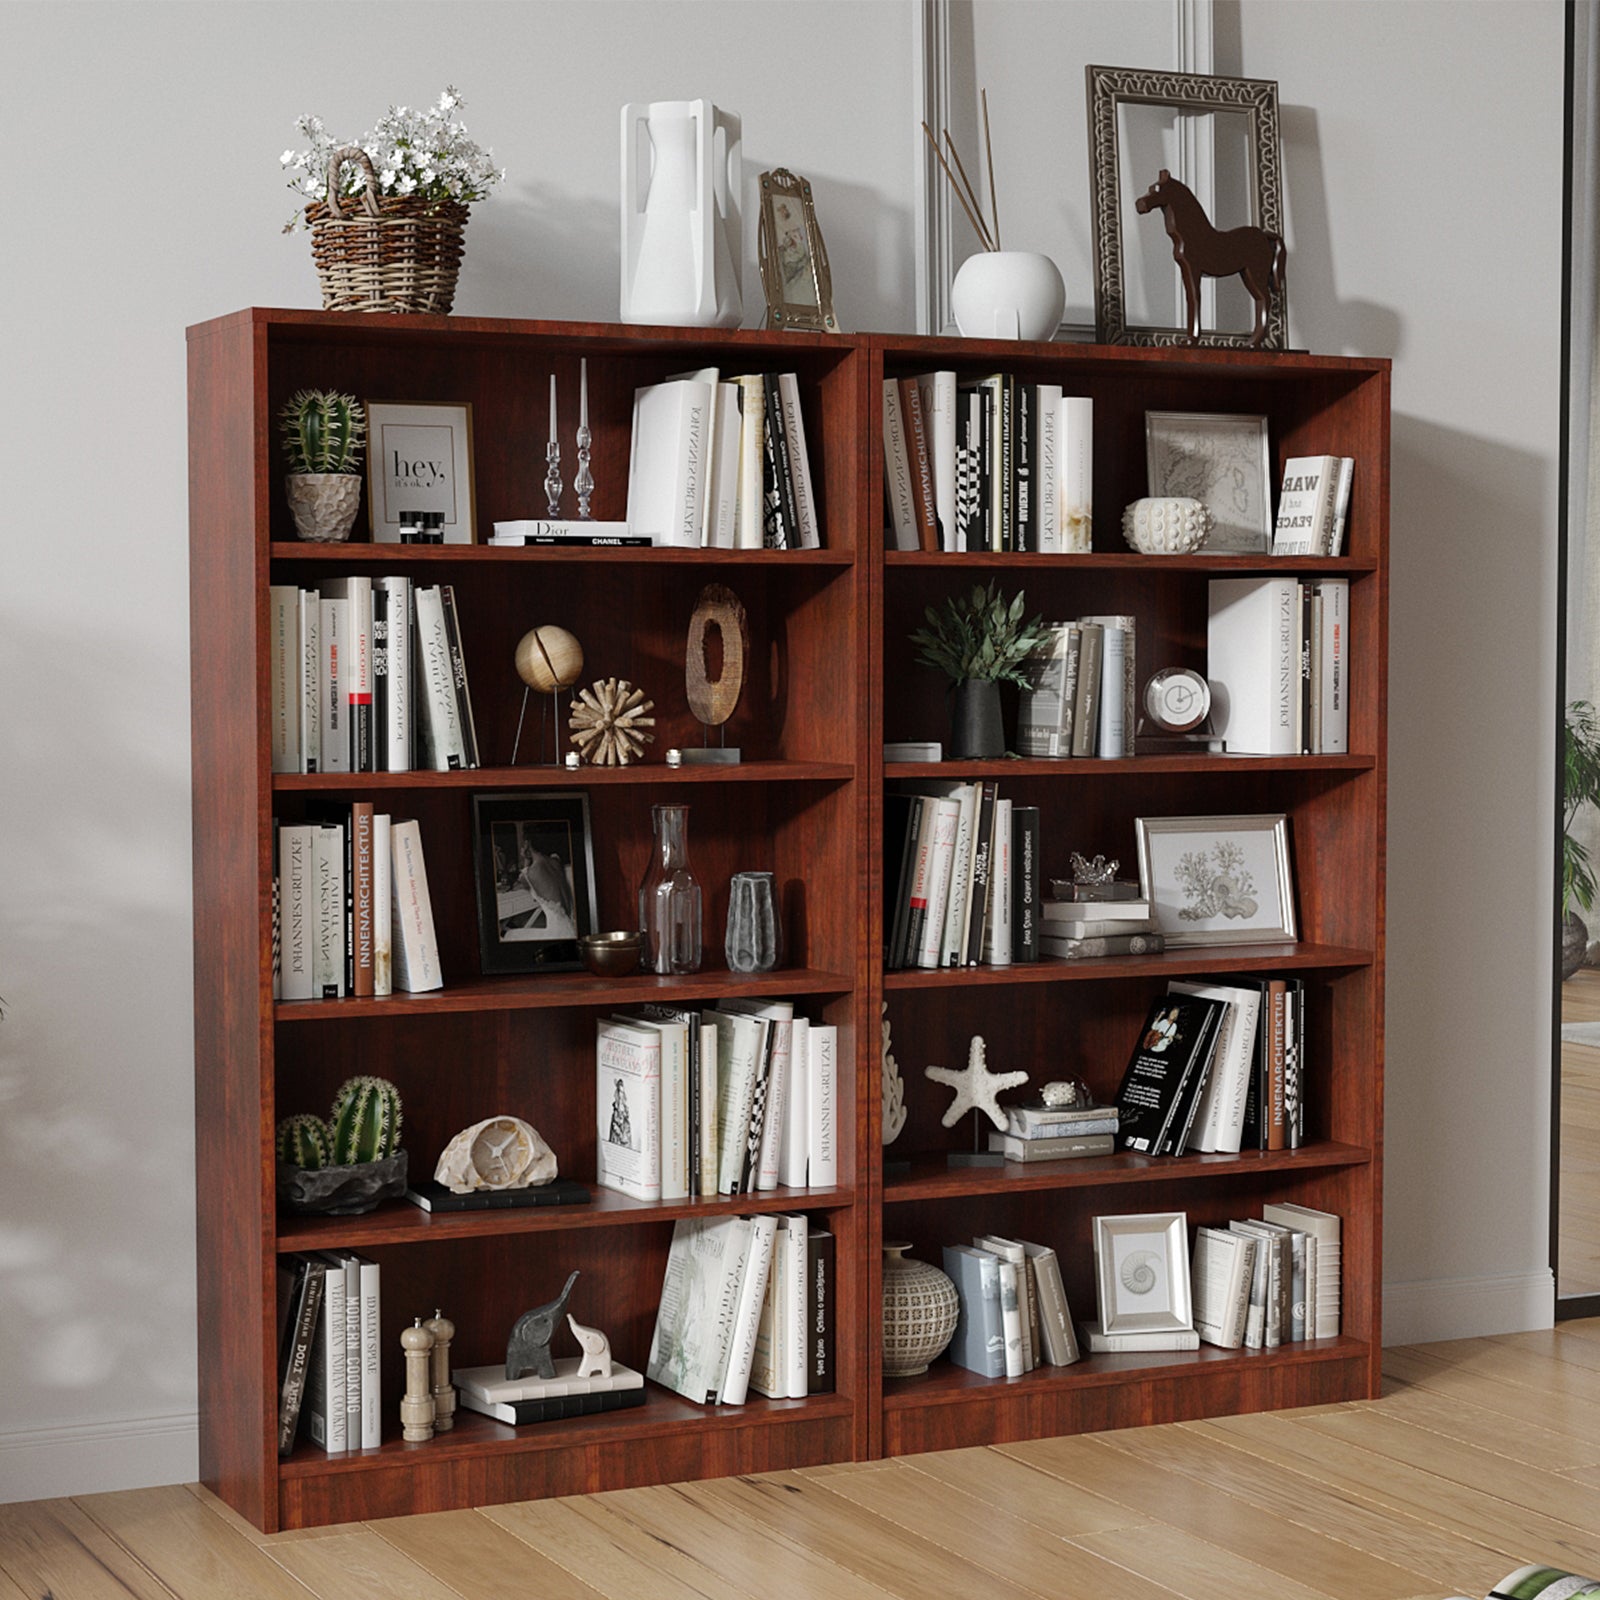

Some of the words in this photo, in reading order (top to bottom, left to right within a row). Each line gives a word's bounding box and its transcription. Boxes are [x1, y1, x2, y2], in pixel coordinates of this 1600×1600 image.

[393, 451, 446, 488] hey,
[536, 522, 570, 536] Dior
[592, 537, 623, 546] CHANEL
[1067, 649, 1077, 677] Sherlock
[1064, 678, 1074, 702] Holmes
[1280, 655, 1291, 728] JOHANNES
[360, 814, 370, 968] INNENARCHITEKTUR
[292, 902, 303, 974] JOHANNES
[1274, 992, 1284, 1126] INNENARCHITEKTUR
[1231, 1064, 1246, 1128] JOHANNES
[820, 1097, 831, 1163] JOHANNES
[331, 1283, 344, 1346] VEGETARIAN
[346, 1296, 360, 1349] MODERN
[293, 1344, 307, 1376] DOLI
[333, 1353, 345, 1389] INDIAN
[347, 1357, 361, 1413] COOKING
[286, 1380, 301, 1409] AMET
[334, 1395, 345, 1442] COOKING
